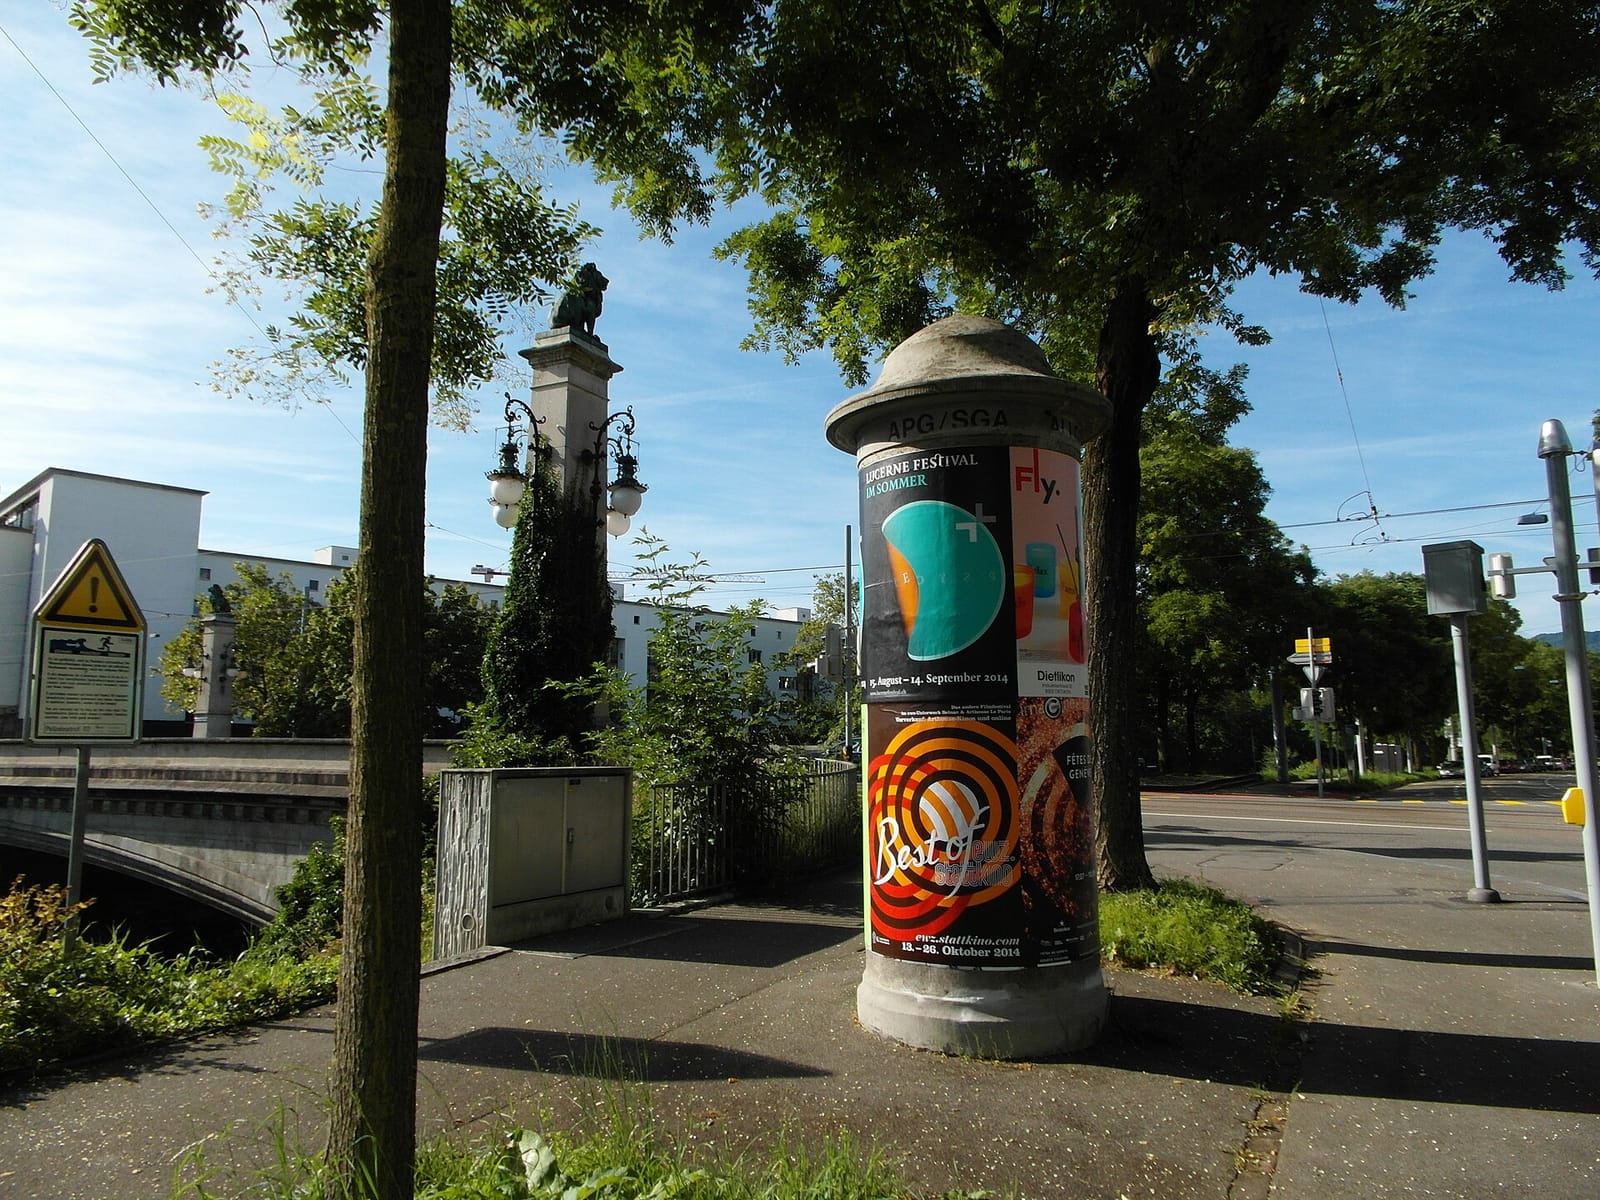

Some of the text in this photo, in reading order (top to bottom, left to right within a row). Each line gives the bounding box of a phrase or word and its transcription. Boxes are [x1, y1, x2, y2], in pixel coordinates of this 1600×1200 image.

[888, 408, 1009, 441] APG/SGA
[866, 453, 978, 484] LUCERNE FESTIVAL
[1015, 447, 1060, 504] Fly.
[866, 474, 928, 499] IM SOMMER
[878, 676, 903, 688] August
[910, 676, 924, 686] 14.
[926, 672, 982, 685] September
[984, 674, 1009, 684] 2014
[1037, 670, 1076, 683] Dietlikon
[873, 805, 990, 900] Best of
[914, 933, 1020, 946] ewz.stattkino.com
[941, 945, 991, 957] Oktober
[993, 947, 1021, 957] 2014
